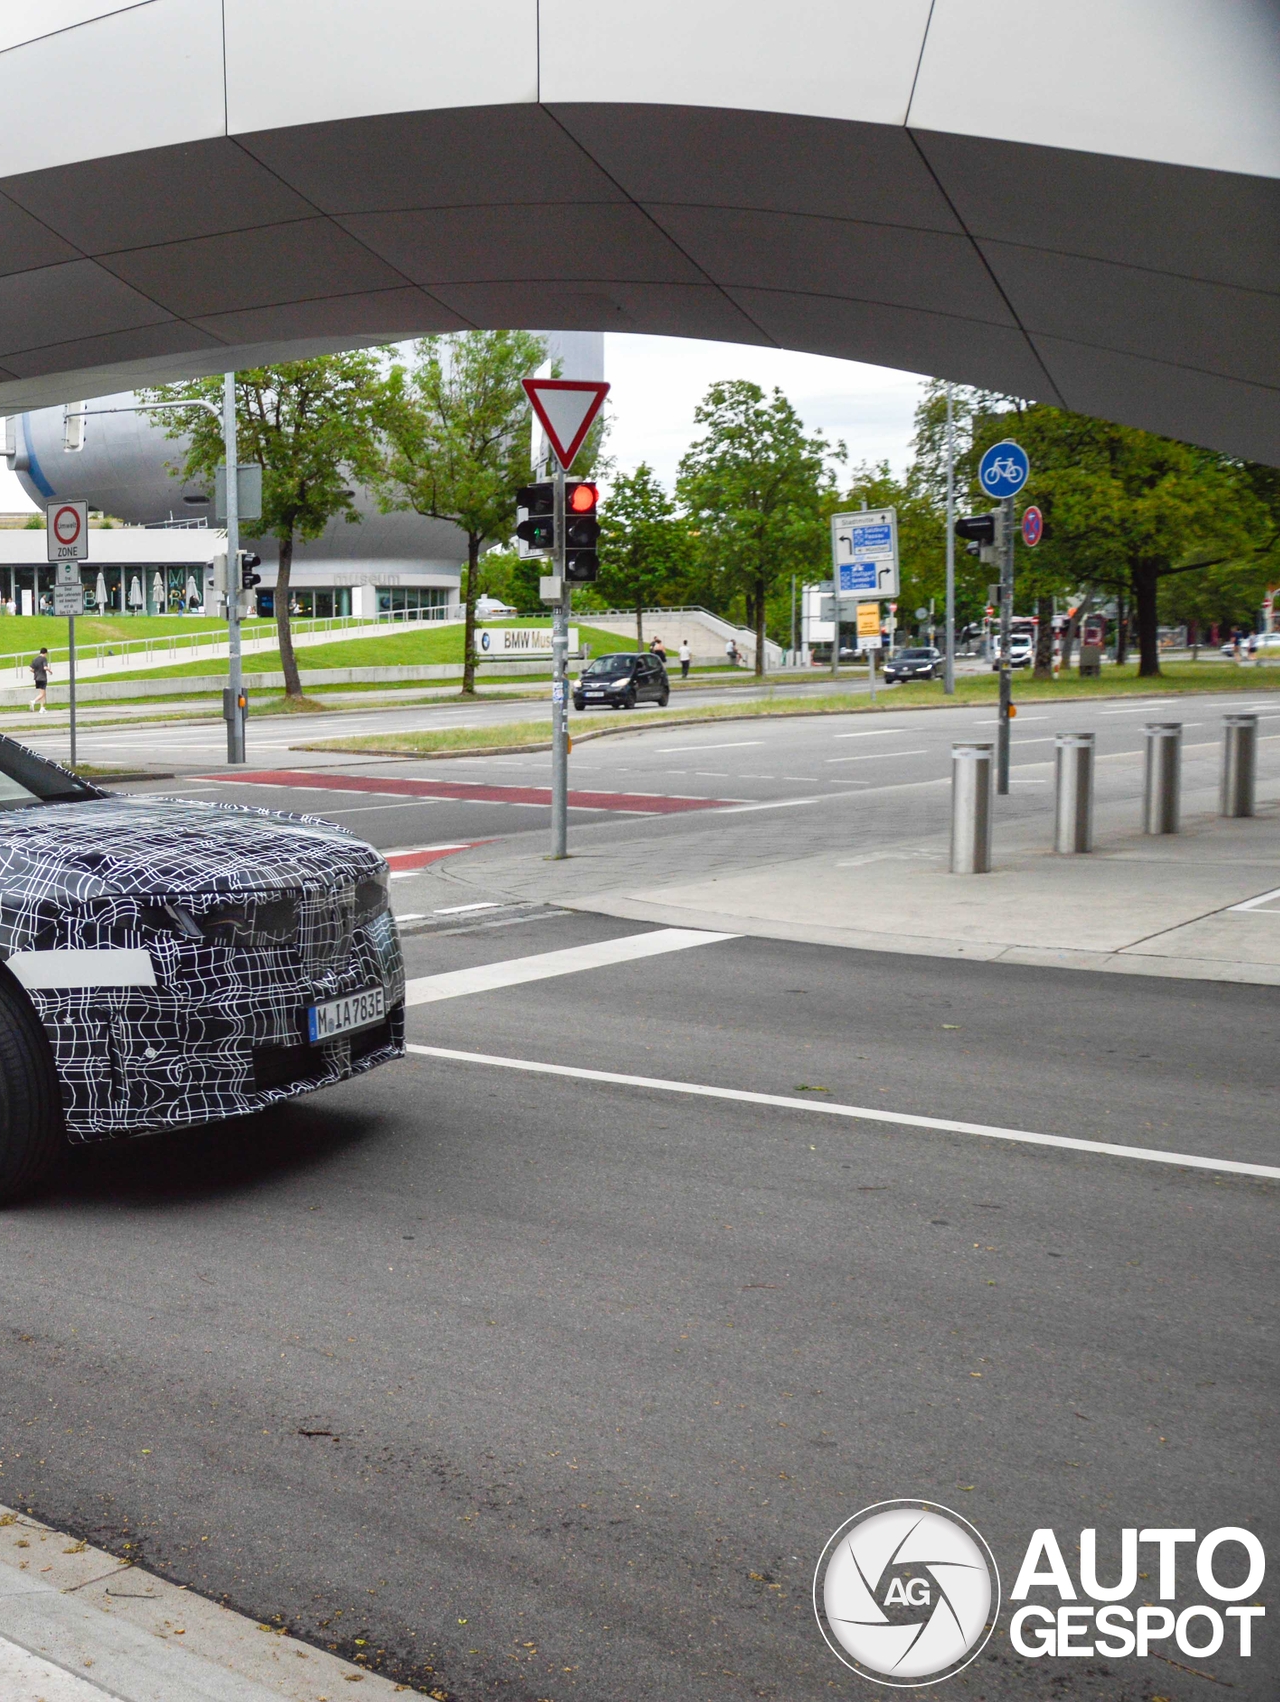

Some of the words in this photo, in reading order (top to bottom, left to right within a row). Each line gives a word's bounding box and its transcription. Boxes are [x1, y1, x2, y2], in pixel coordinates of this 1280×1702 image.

[57, 521, 77, 529] Umwelt
[57, 546, 78, 557] ZONE
[334, 573, 400, 586] museum
[504, 630, 530, 649] BMW
[531, 631, 554, 648] Mus
